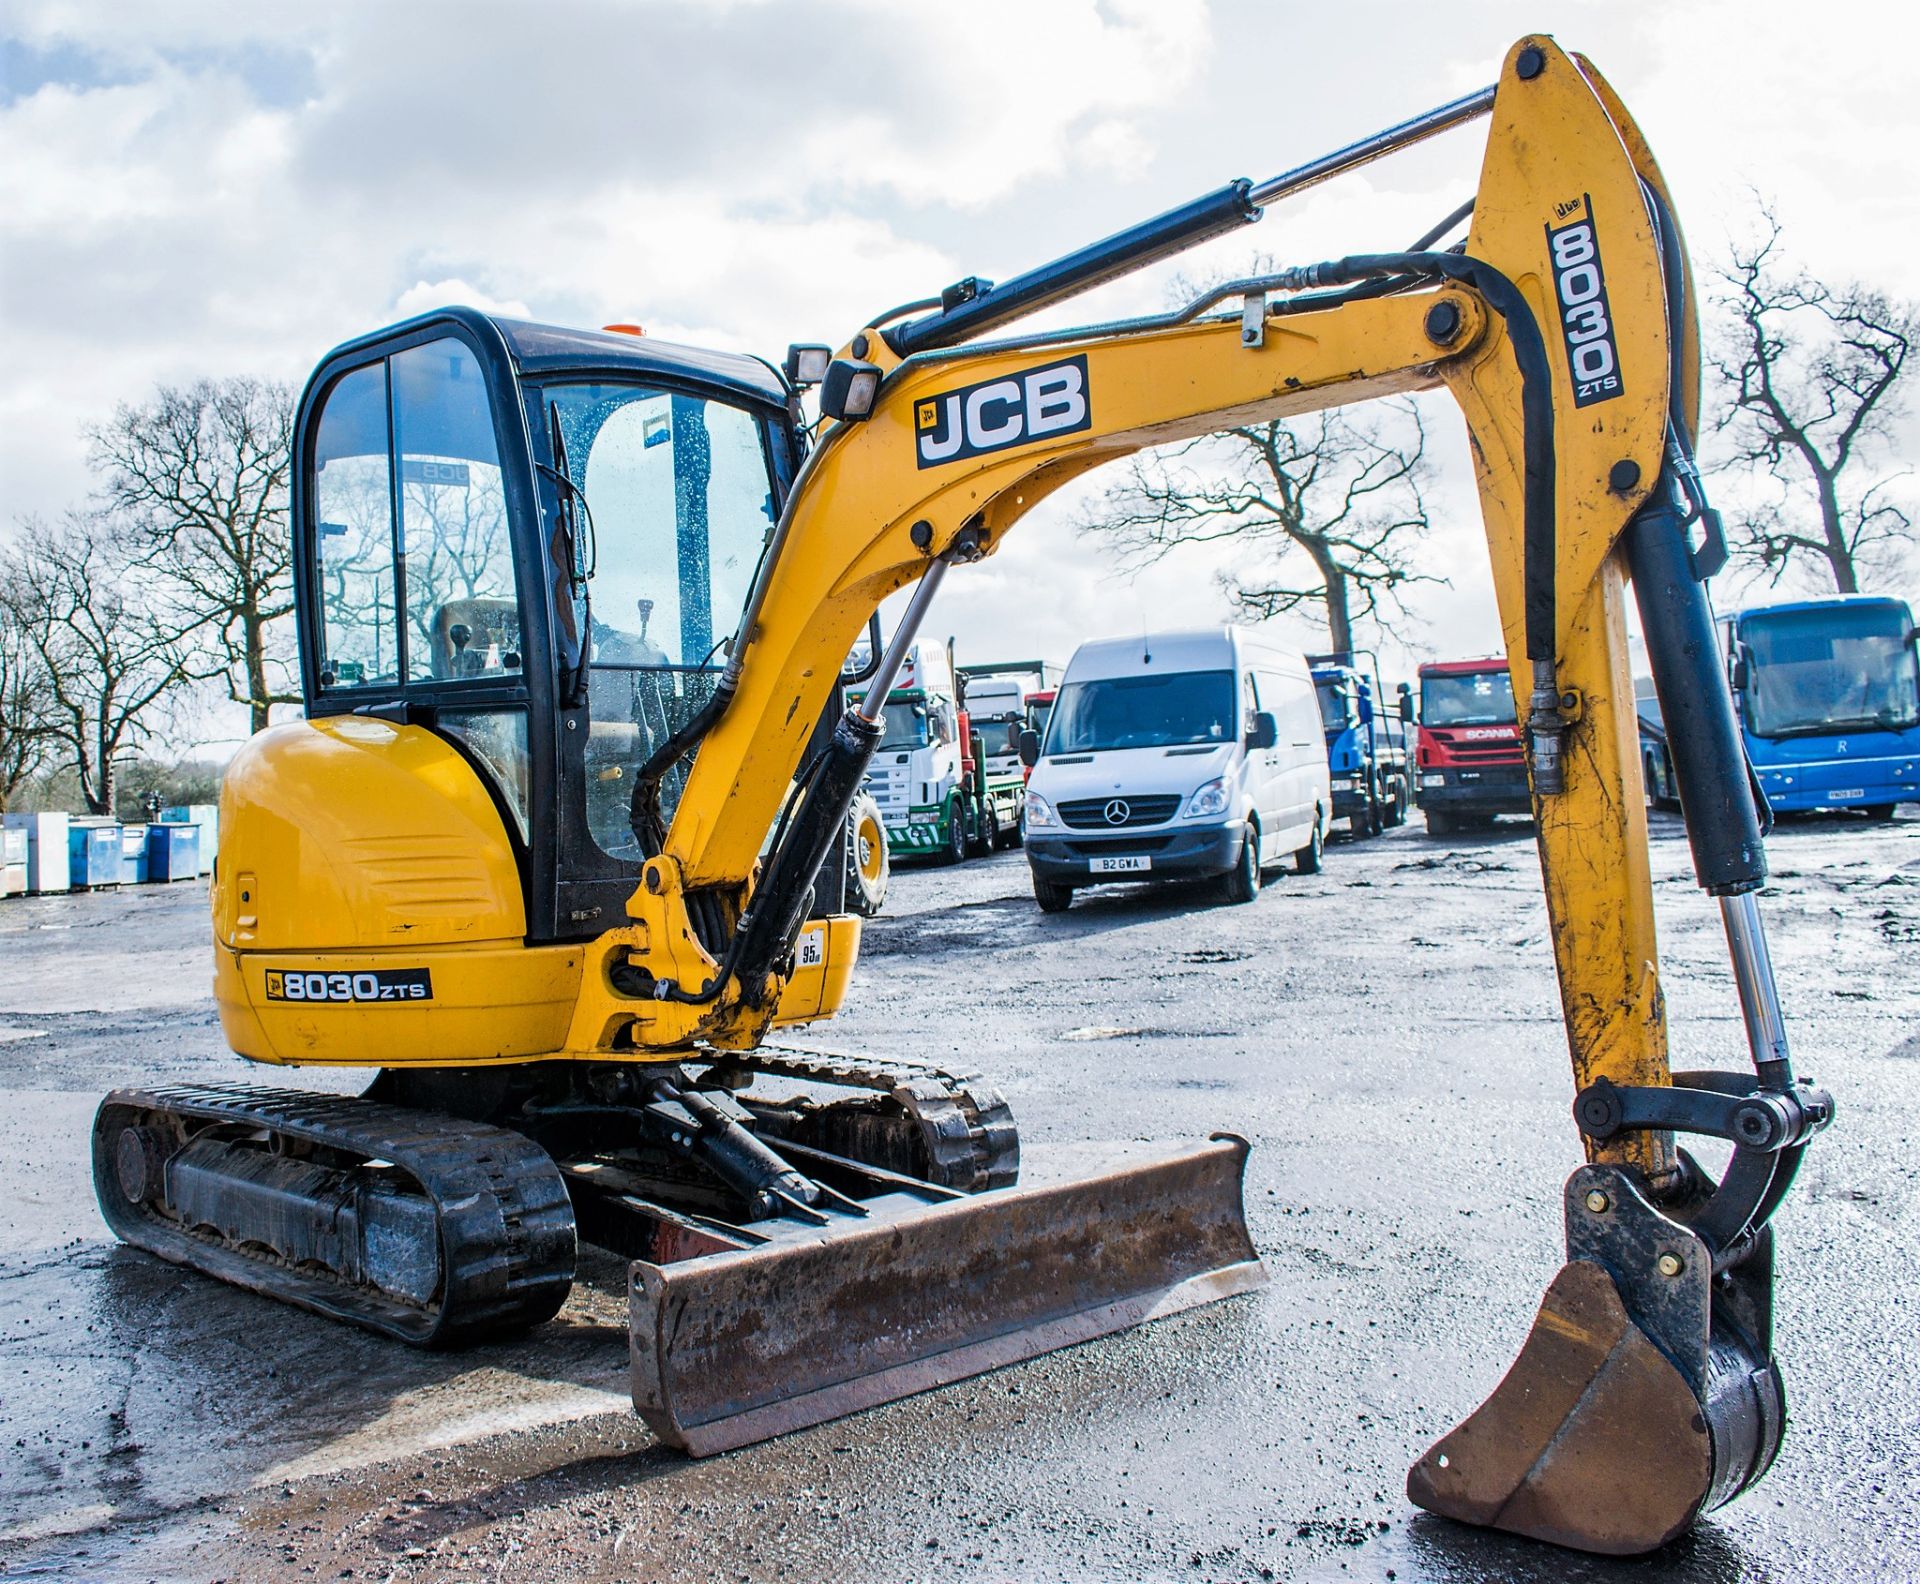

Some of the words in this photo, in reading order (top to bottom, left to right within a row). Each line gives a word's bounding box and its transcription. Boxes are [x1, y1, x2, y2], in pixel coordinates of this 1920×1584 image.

[1552, 224, 1614, 381] 8030
[1577, 376, 1618, 398] ZTS
[920, 364, 1086, 460] JCB
[1465, 728, 1515, 739] SCANIA
[1103, 859, 1116, 869] B2
[1119, 859, 1139, 868] GWA
[803, 945, 815, 963] 95
[284, 974, 379, 999] 8030
[380, 984, 426, 998] ZTS
